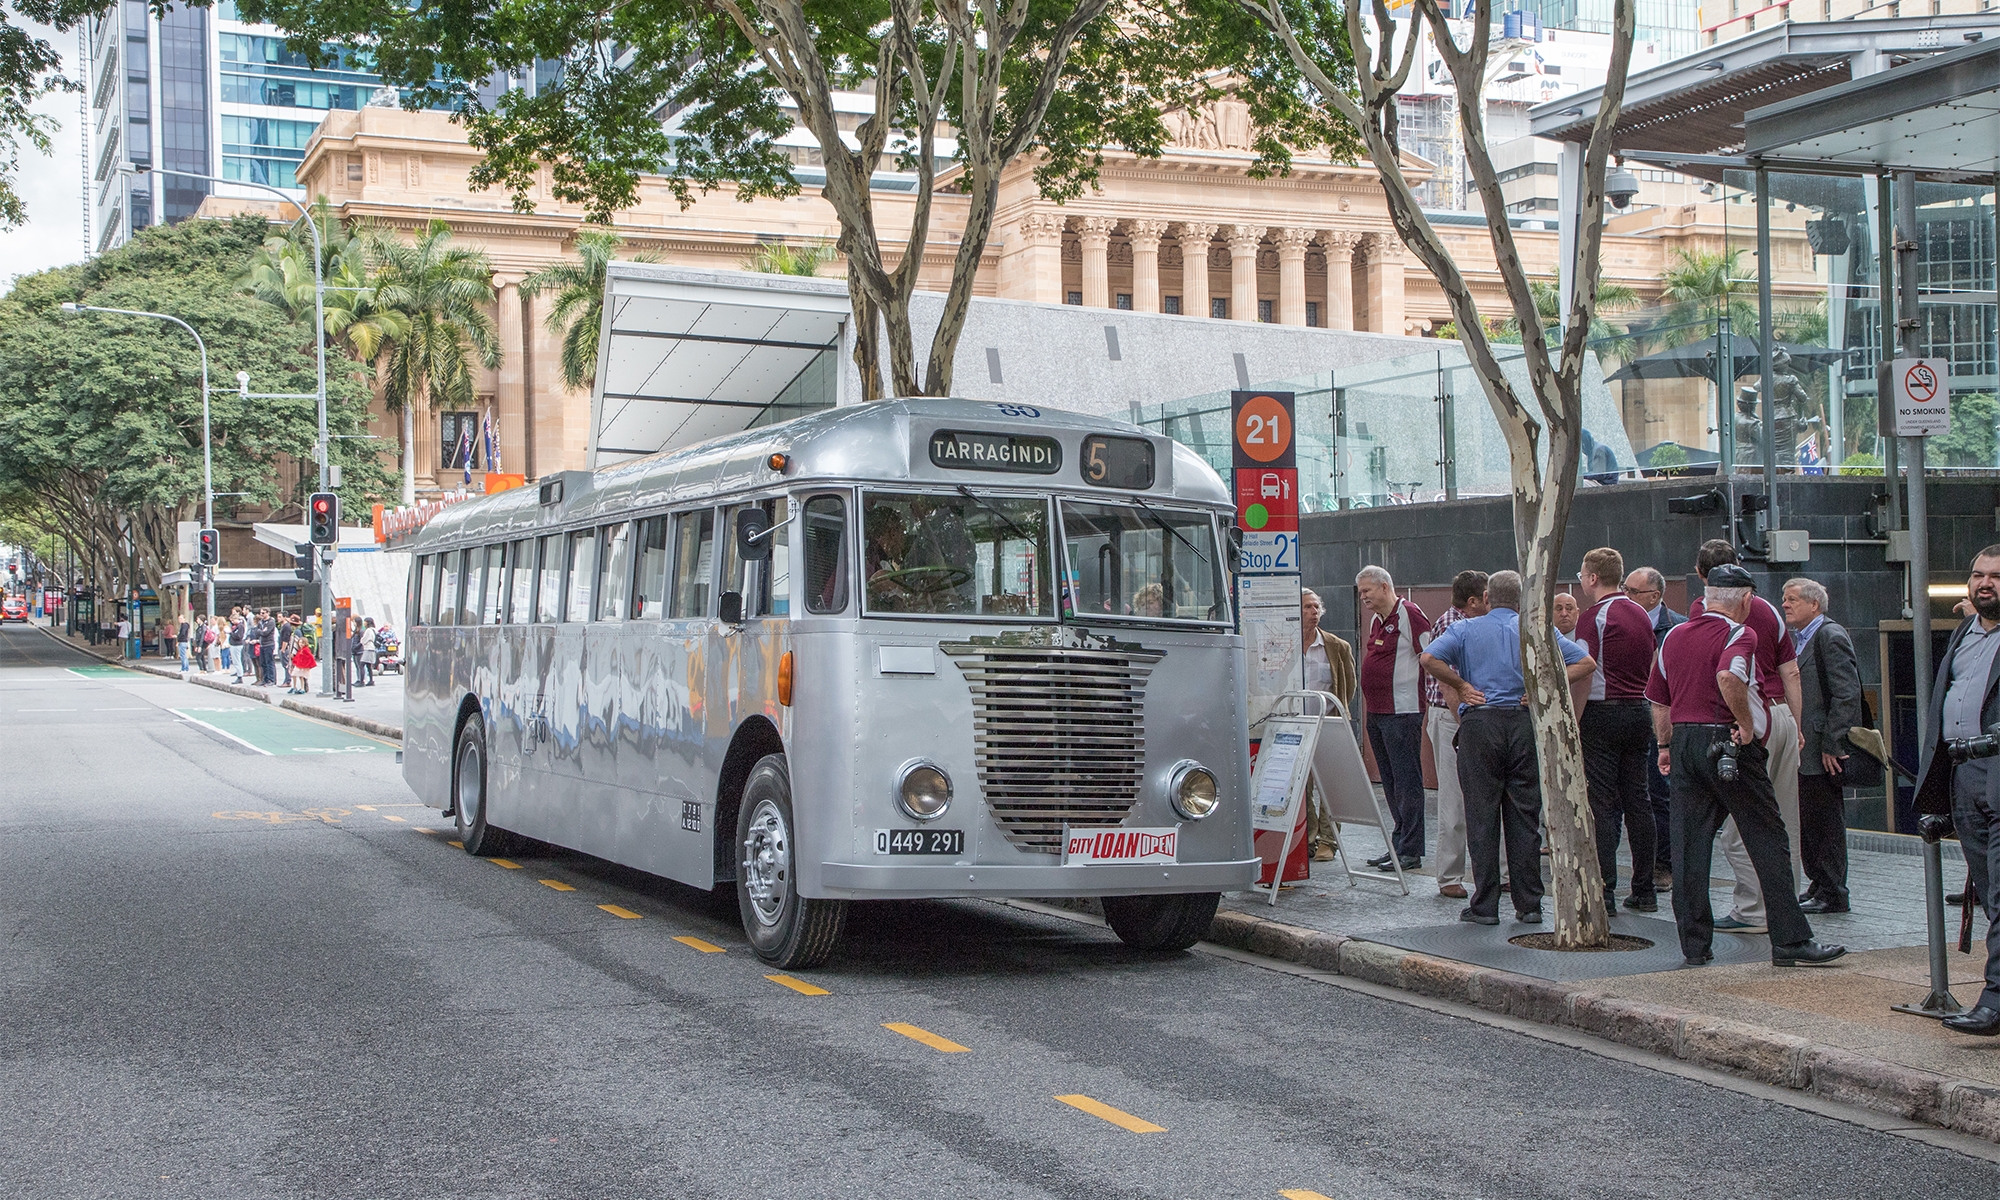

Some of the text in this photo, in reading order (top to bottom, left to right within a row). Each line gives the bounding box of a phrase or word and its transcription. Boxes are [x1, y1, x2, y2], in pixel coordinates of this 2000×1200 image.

[997, 402, 1041, 419] 80
[1912, 408, 1946, 416] SMOKING
[1245, 414, 1279, 444] 21
[934, 440, 1052, 464] TARRAGINDI
[1088, 442, 1107, 481] 5
[1241, 533, 1299, 572] Stop 21
[877, 832, 961, 853] Q 449 291
[1068, 831, 1175, 859] CITY LOAN OPEN
